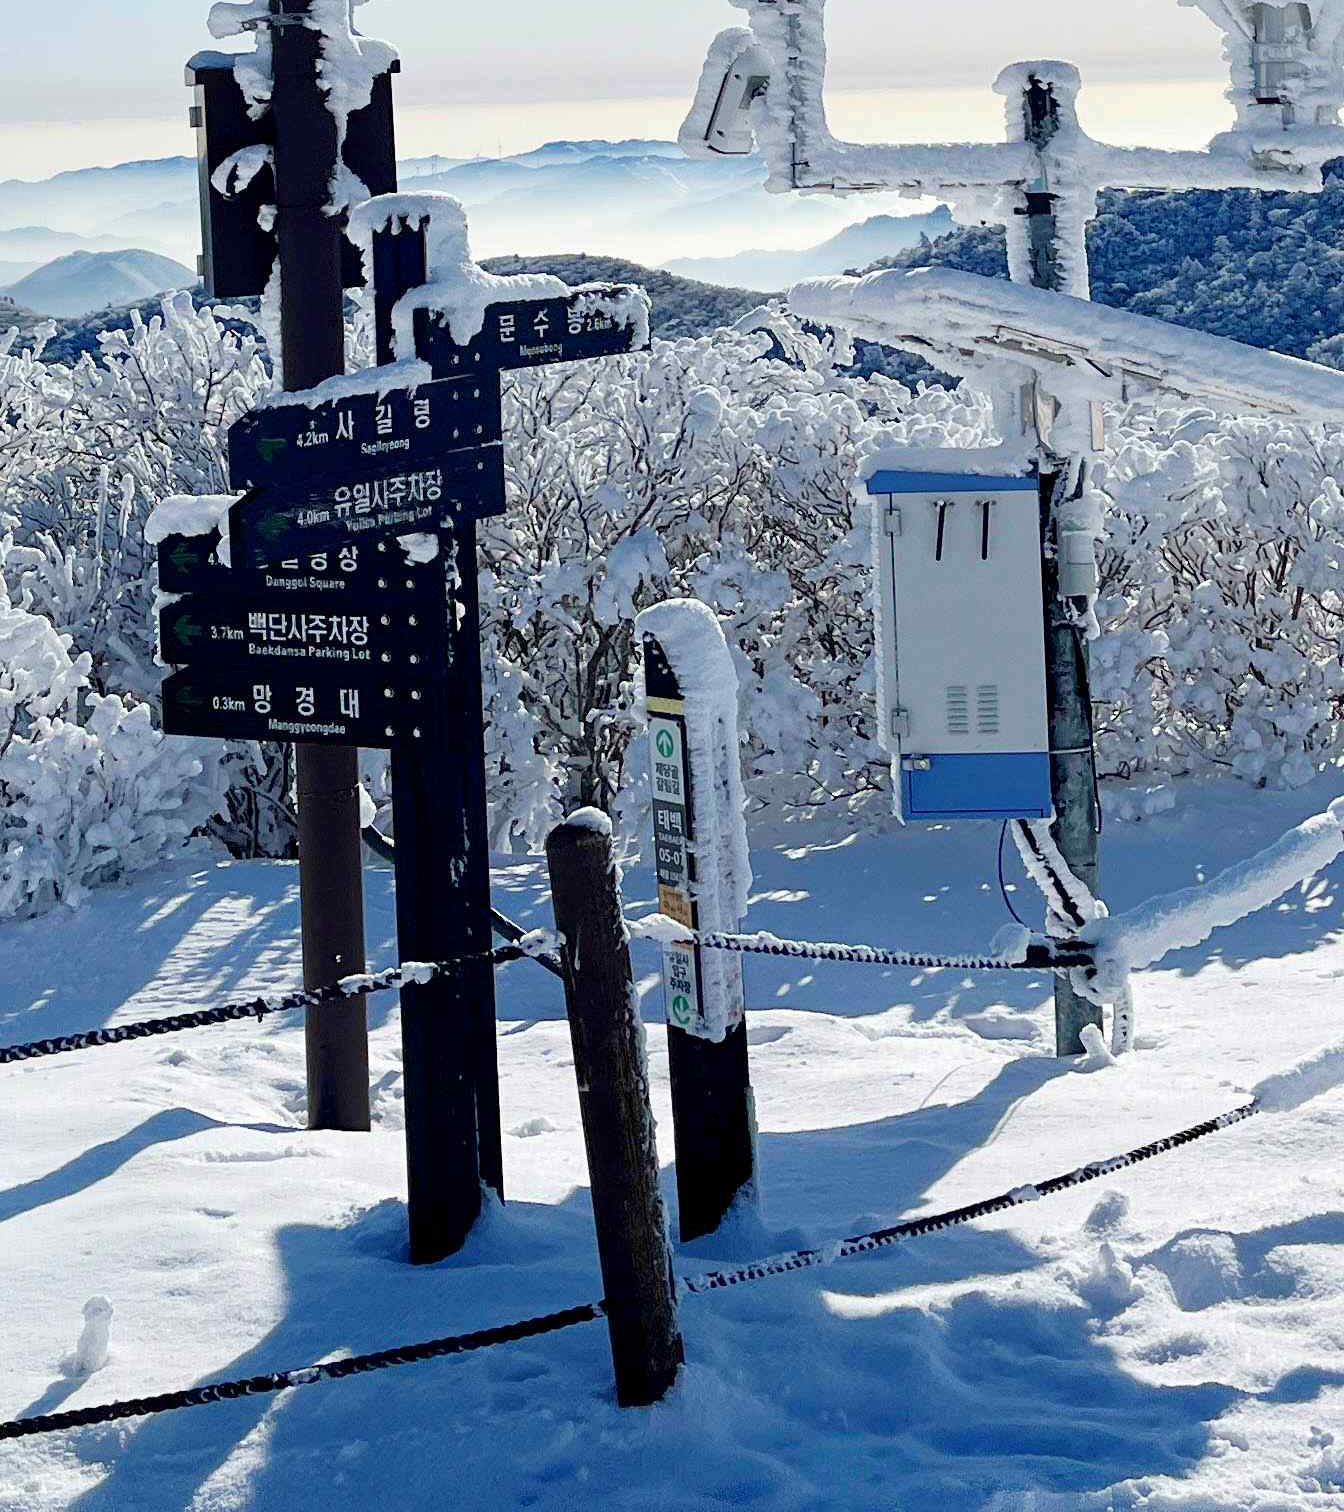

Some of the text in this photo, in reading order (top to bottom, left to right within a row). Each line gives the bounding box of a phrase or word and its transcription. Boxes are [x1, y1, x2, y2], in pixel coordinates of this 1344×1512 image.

[297, 431, 329, 448] 4.2km
[297, 469, 443, 528] 4.0km 유일사주차장
[309, 576, 346, 590] Square
[211, 612, 370, 646] 3.7km 백단사주차장
[248, 643, 371, 662] Baekdansa Parking Lot
[212, 696, 246, 711] 0.3km
[658, 809, 682, 834] 태백
